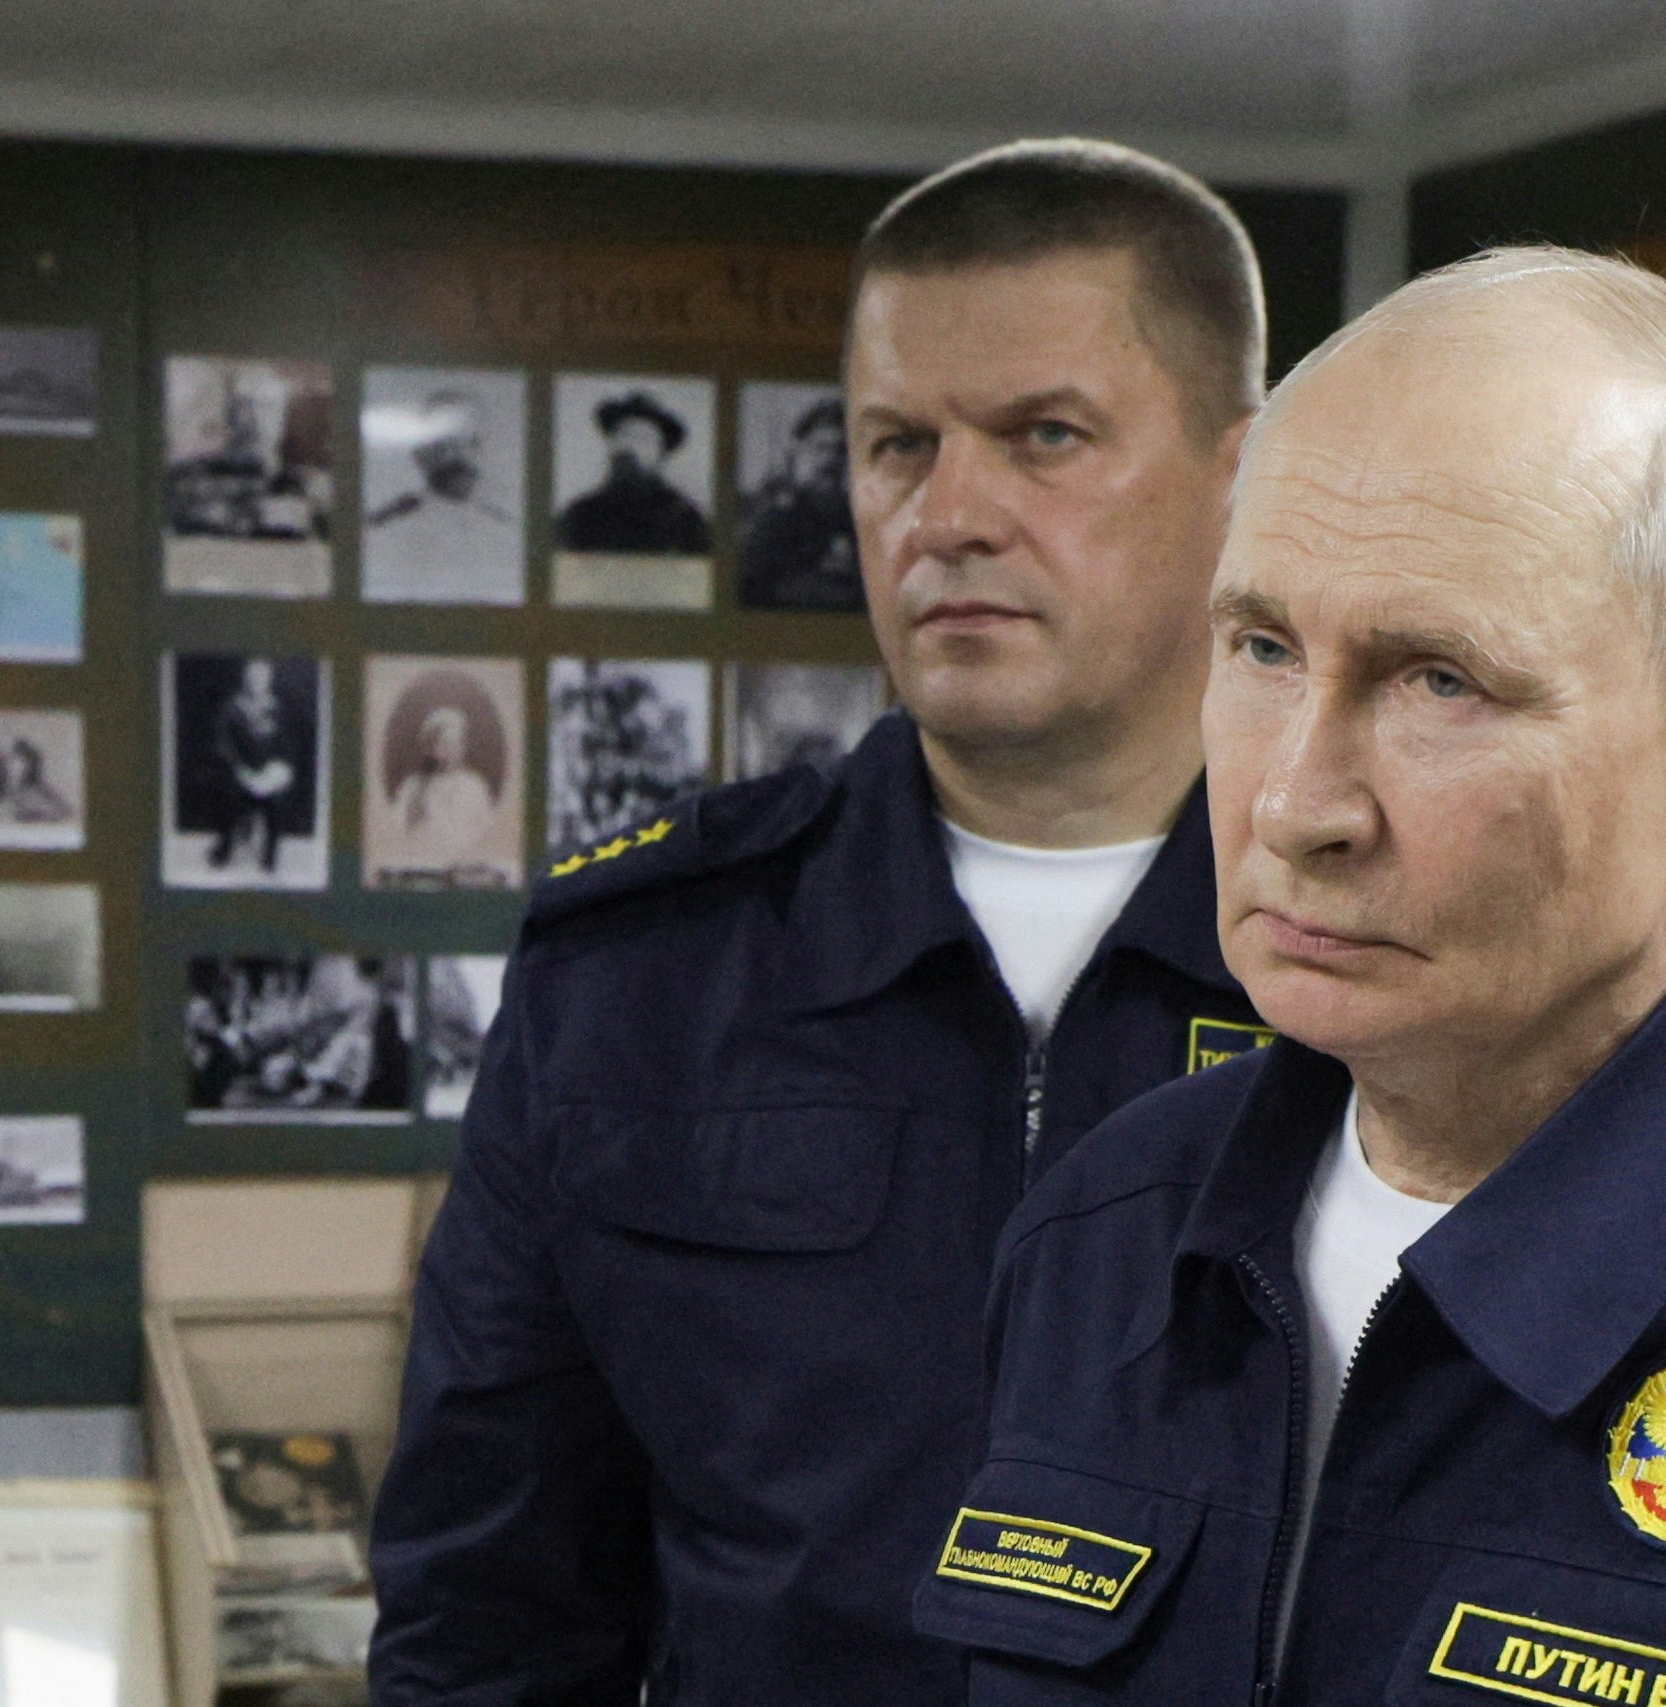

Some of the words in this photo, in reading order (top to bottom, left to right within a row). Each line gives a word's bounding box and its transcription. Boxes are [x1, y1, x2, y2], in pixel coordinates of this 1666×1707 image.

[997, 1530, 1070, 1558] ВЕРХОВНЫЙ
[948, 1546, 1074, 1585] ГЛАВНОКОМАНДУЮЩИЙ
[1071, 1570, 1093, 1591] ВС
[1092, 1575, 1118, 1597] РФ
[1495, 1635, 1646, 1706] ПУТИН
